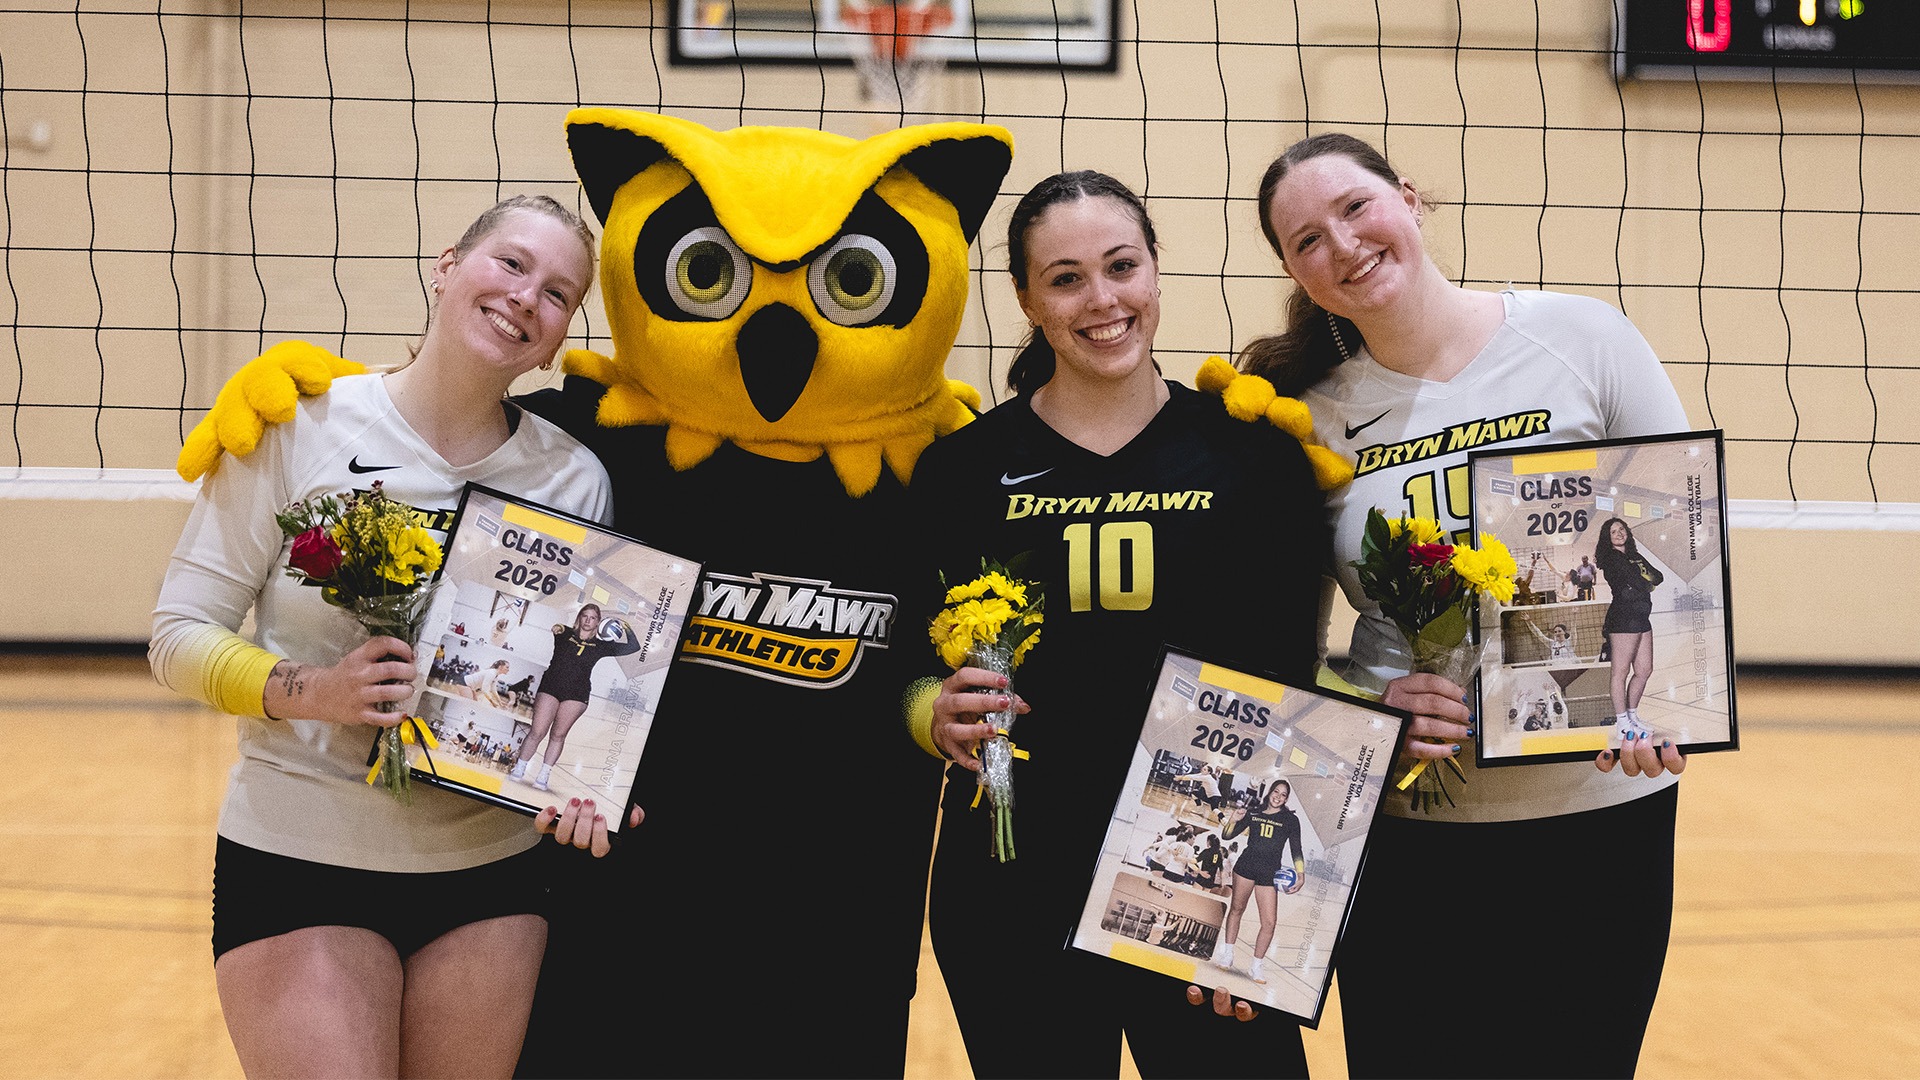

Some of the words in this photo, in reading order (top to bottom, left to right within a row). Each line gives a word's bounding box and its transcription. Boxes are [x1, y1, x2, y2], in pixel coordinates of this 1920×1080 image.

[1358, 434, 1444, 474] BRYN
[1446, 411, 1548, 452] MAWR
[1005, 494, 1102, 520] BRYN
[1104, 490, 1214, 513] MAWR
[1520, 476, 1592, 501] CLASS
[1694, 474, 1702, 525] VOLLEYBALL
[1527, 509, 1588, 536] 2026
[502, 529, 573, 566] CLASS
[1062, 521, 1155, 612] 10
[495, 560, 558, 595] 2026
[638, 642, 649, 663] BRYN
[645, 620, 656, 643] MAWR
[652, 586, 667, 620] COLLEGE
[655, 589, 674, 634] VOLLEYBALL
[697, 580, 762, 621] YN
[758, 584, 893, 638] MAWR
[1690, 586, 1704, 643] PERRY
[577, 644, 585, 656] 7
[684, 623, 841, 672] ATHLETICS
[1693, 648, 1707, 697] ELISE
[1198, 691, 1271, 728] CLASS
[1223, 722, 1235, 730] OF
[598, 736, 623, 786] ANNA
[1190, 725, 1255, 761] 2026
[1336, 807, 1347, 830] BRYN
[1343, 782, 1355, 807] MAWR
[1351, 744, 1367, 782] COLLEGE
[1353, 747, 1374, 798] VOLLEYBALL
[1260, 823, 1274, 839] 10
[1294, 920, 1316, 968] MICAH
